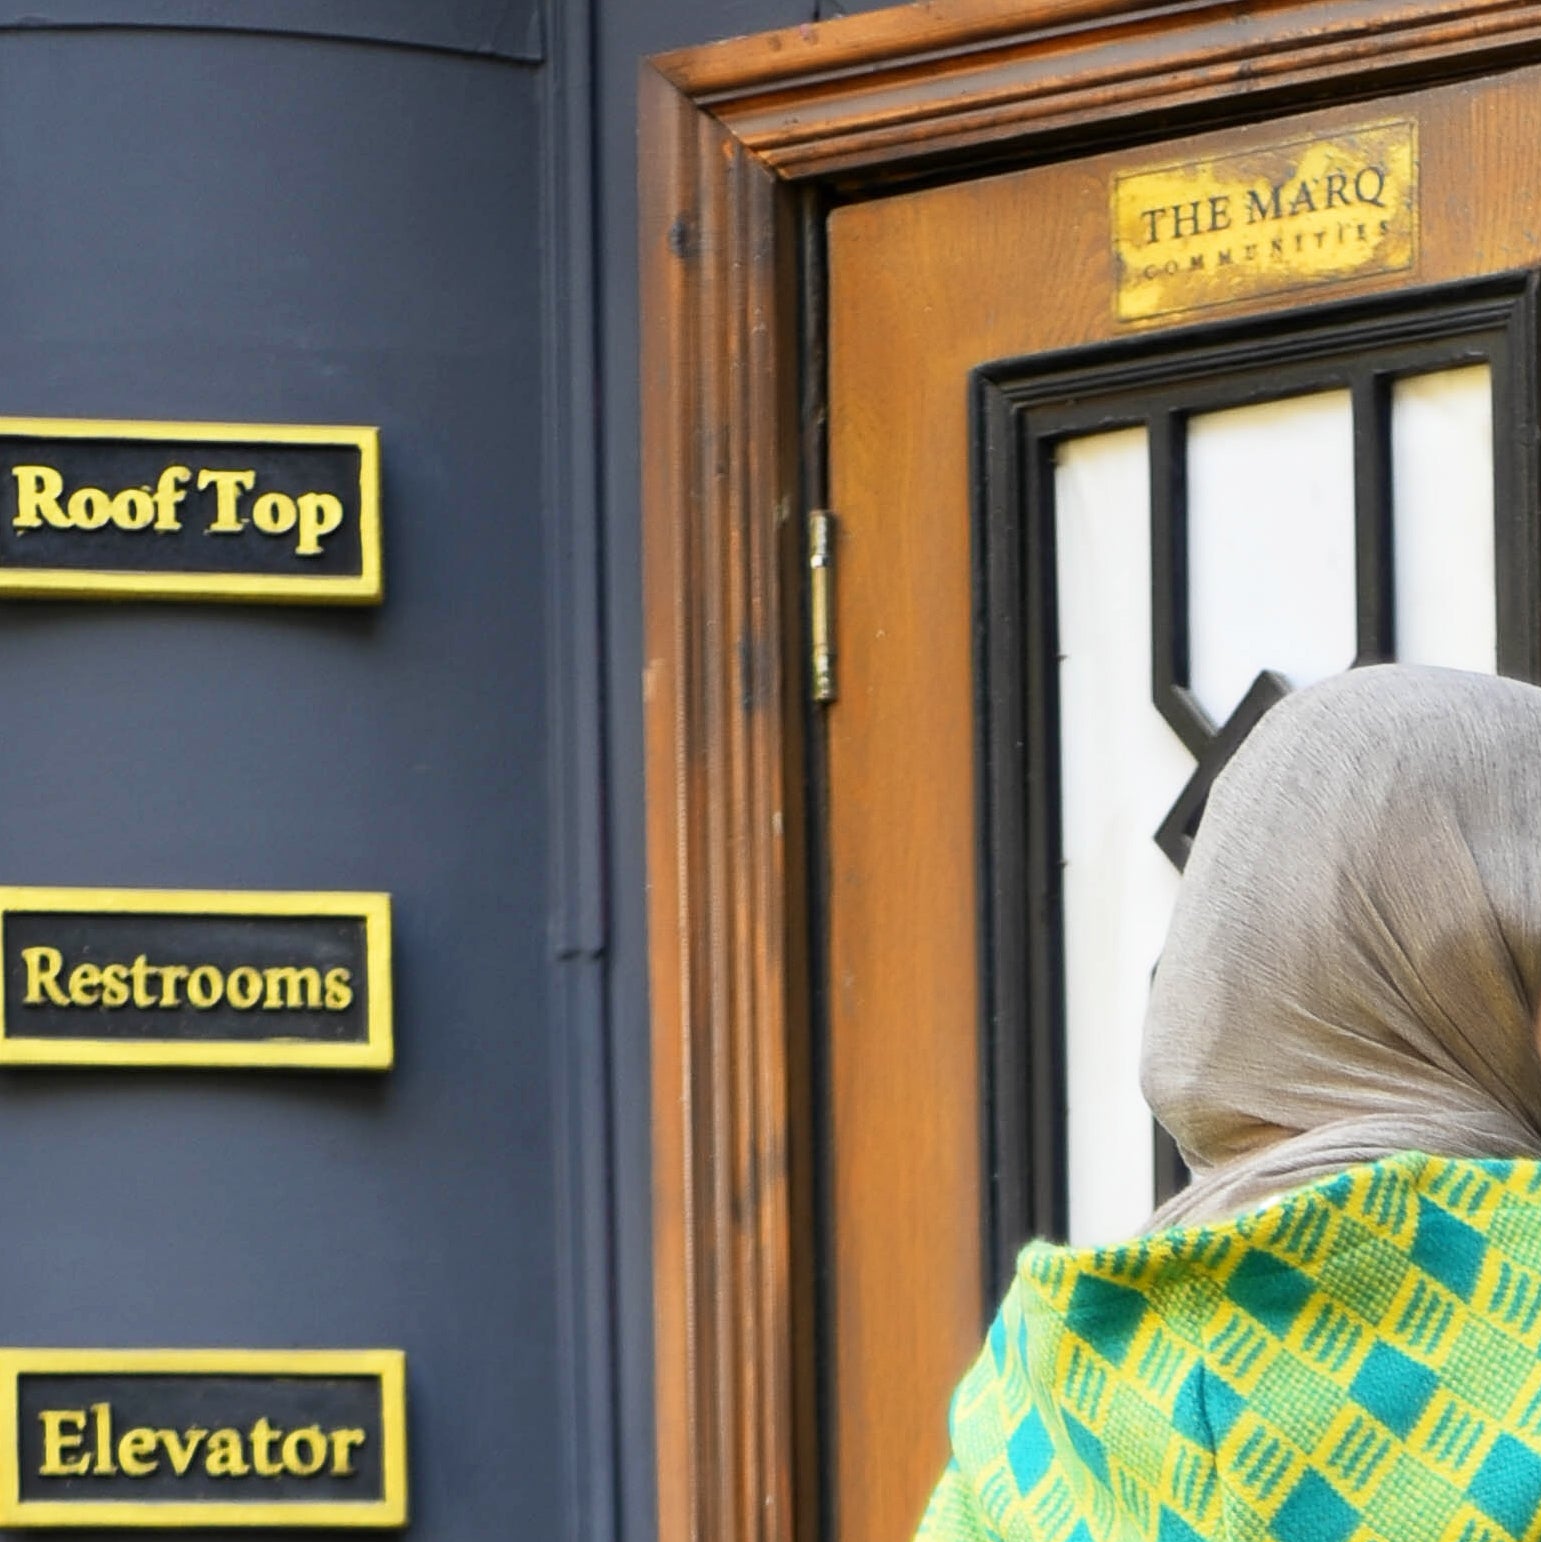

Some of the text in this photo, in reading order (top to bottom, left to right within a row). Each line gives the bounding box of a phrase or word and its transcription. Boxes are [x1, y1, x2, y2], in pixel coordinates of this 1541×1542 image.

[1141, 166, 1387, 243] THE MARQ
[1143, 219, 1390, 280] COMMUNITIES
[12, 464, 343, 555] Roof Top
[21, 945, 353, 1011] Restrooms
[38, 1402, 365, 1477] Elevator
